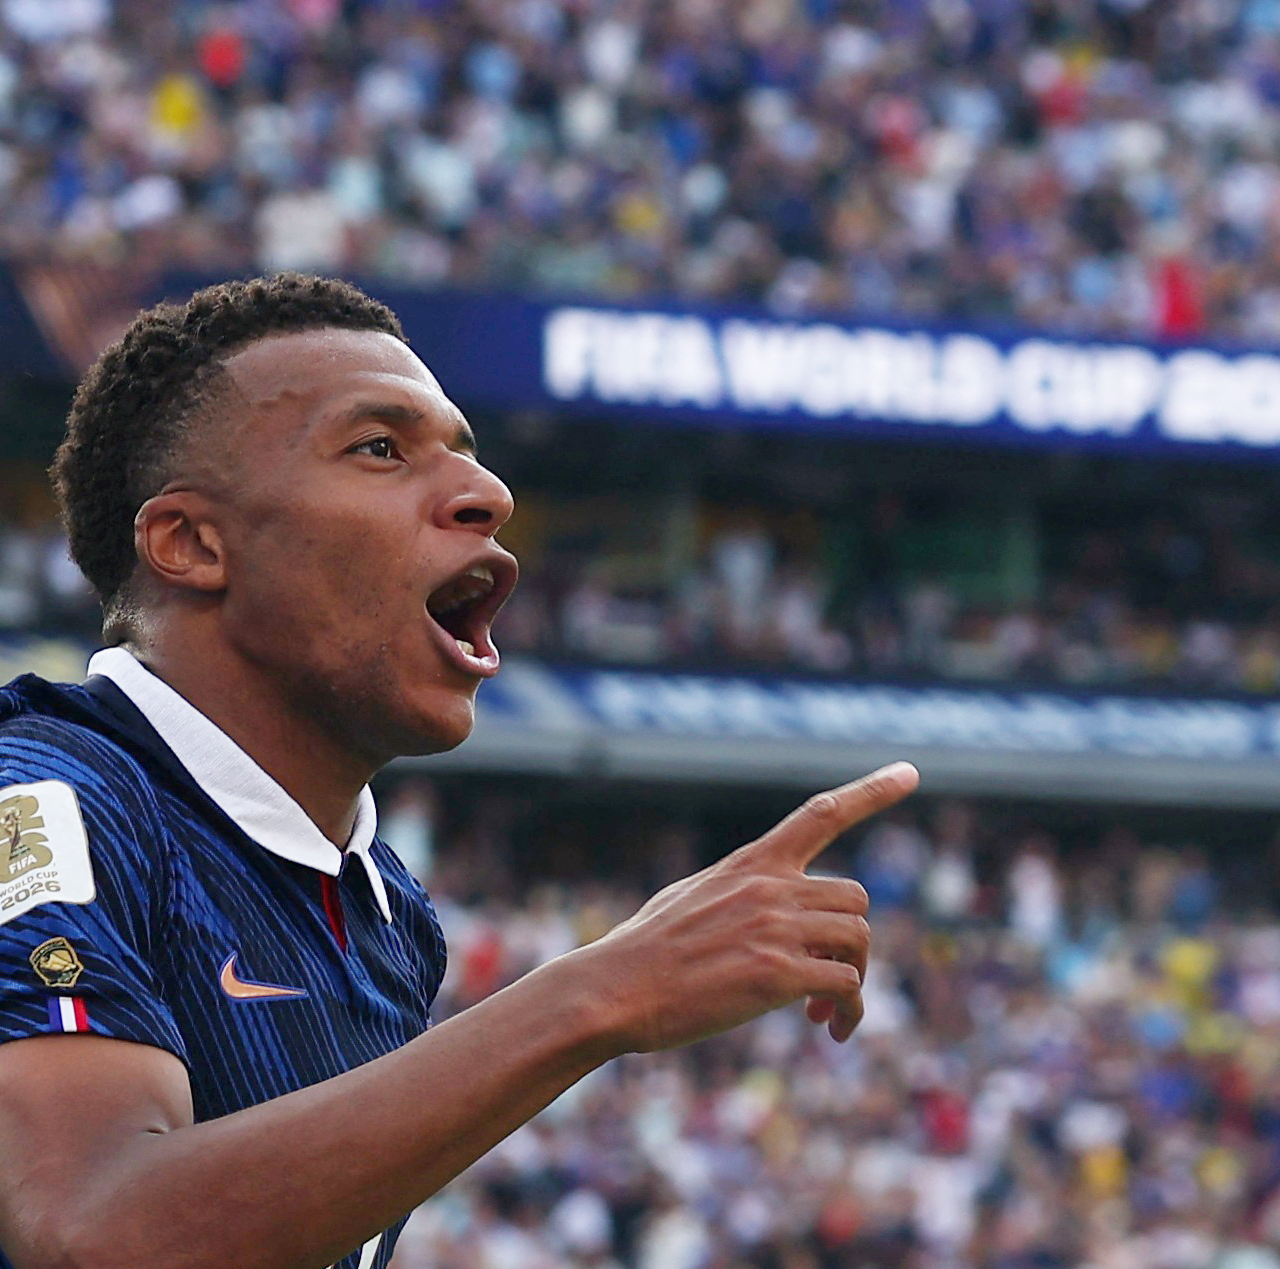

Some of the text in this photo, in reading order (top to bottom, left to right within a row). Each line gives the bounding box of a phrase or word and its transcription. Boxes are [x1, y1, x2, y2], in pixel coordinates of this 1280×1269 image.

[543, 306, 719, 409] FIFA
[720, 318, 1003, 426] WORLD
[1005, 336, 1162, 437] CUP
[8, 853, 38, 875] FIFA
[35, 870, 59, 880] CUP
[1, 880, 62, 911] 2026
